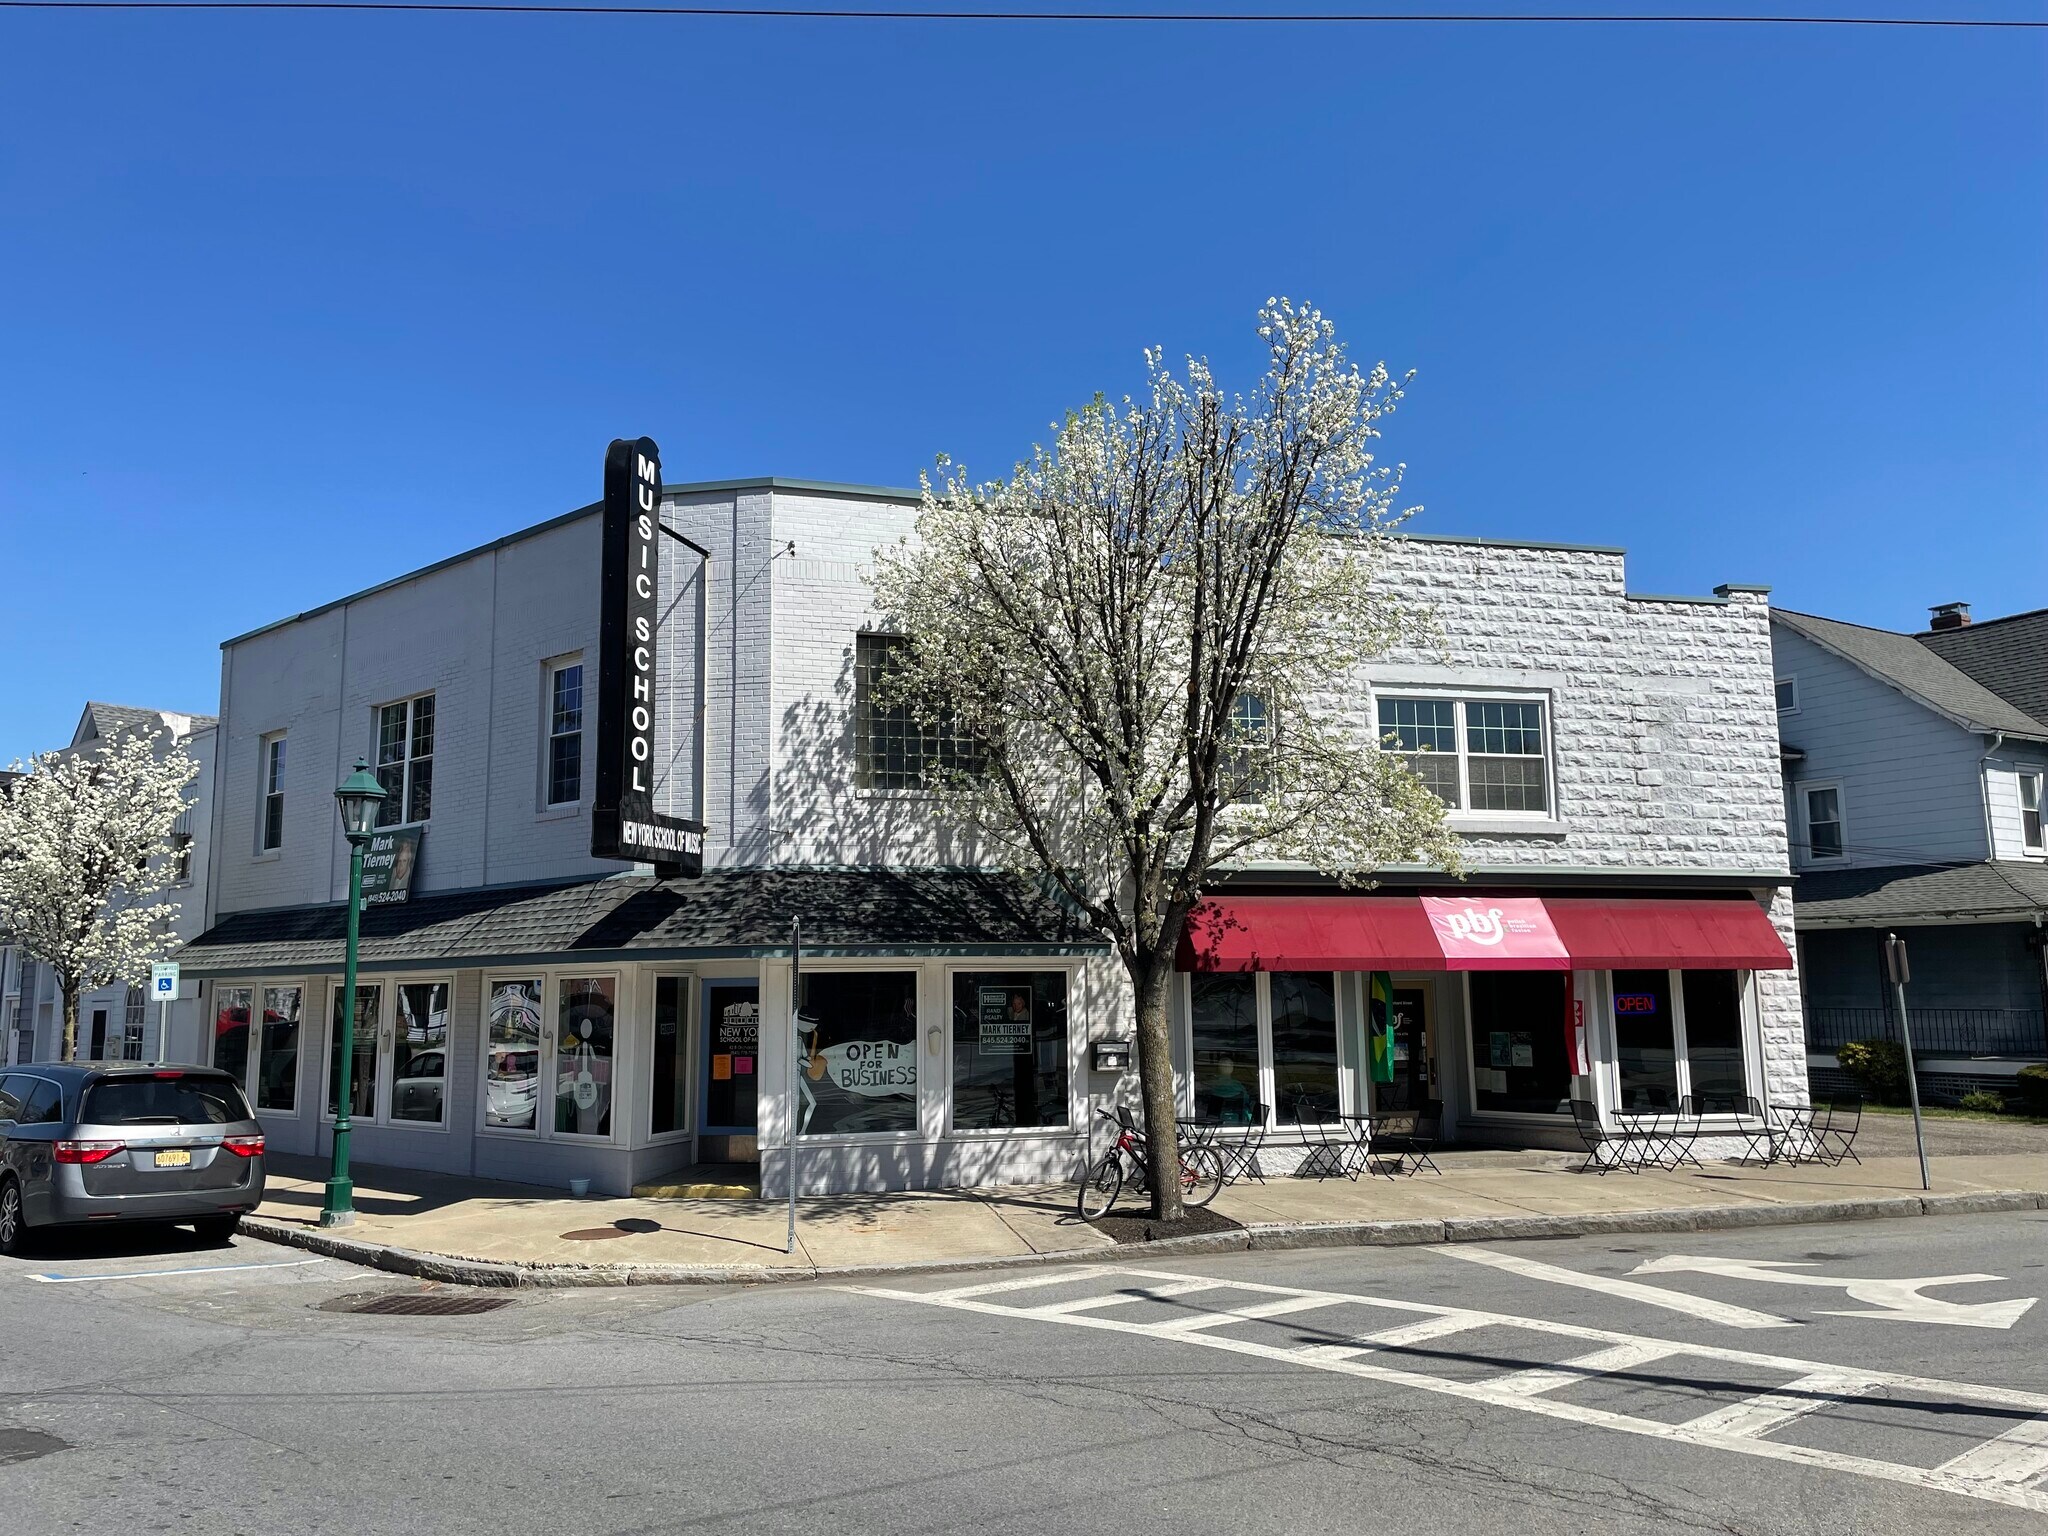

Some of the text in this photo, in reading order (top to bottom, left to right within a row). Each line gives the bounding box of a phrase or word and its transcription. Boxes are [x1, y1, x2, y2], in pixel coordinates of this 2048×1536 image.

[631, 453, 655, 793] MUSIC SCHOOL
[371, 835, 394, 852] Mark
[623, 820, 701, 855] NEW YORK SCHOOL OF MUSIC
[363, 853, 396, 869] Tierney
[1446, 907, 1504, 946] pbf
[1617, 997, 1653, 1011] OPEN
[719, 1027, 759, 1037] NEW YO
[982, 1024, 1029, 1034] MARK TIERNEY
[982, 1036, 1026, 1044] 845.524.2040
[846, 1044, 899, 1061] OPEN
[860, 1060, 883, 1070] FOR
[841, 1066, 917, 1088] BUSINESS
